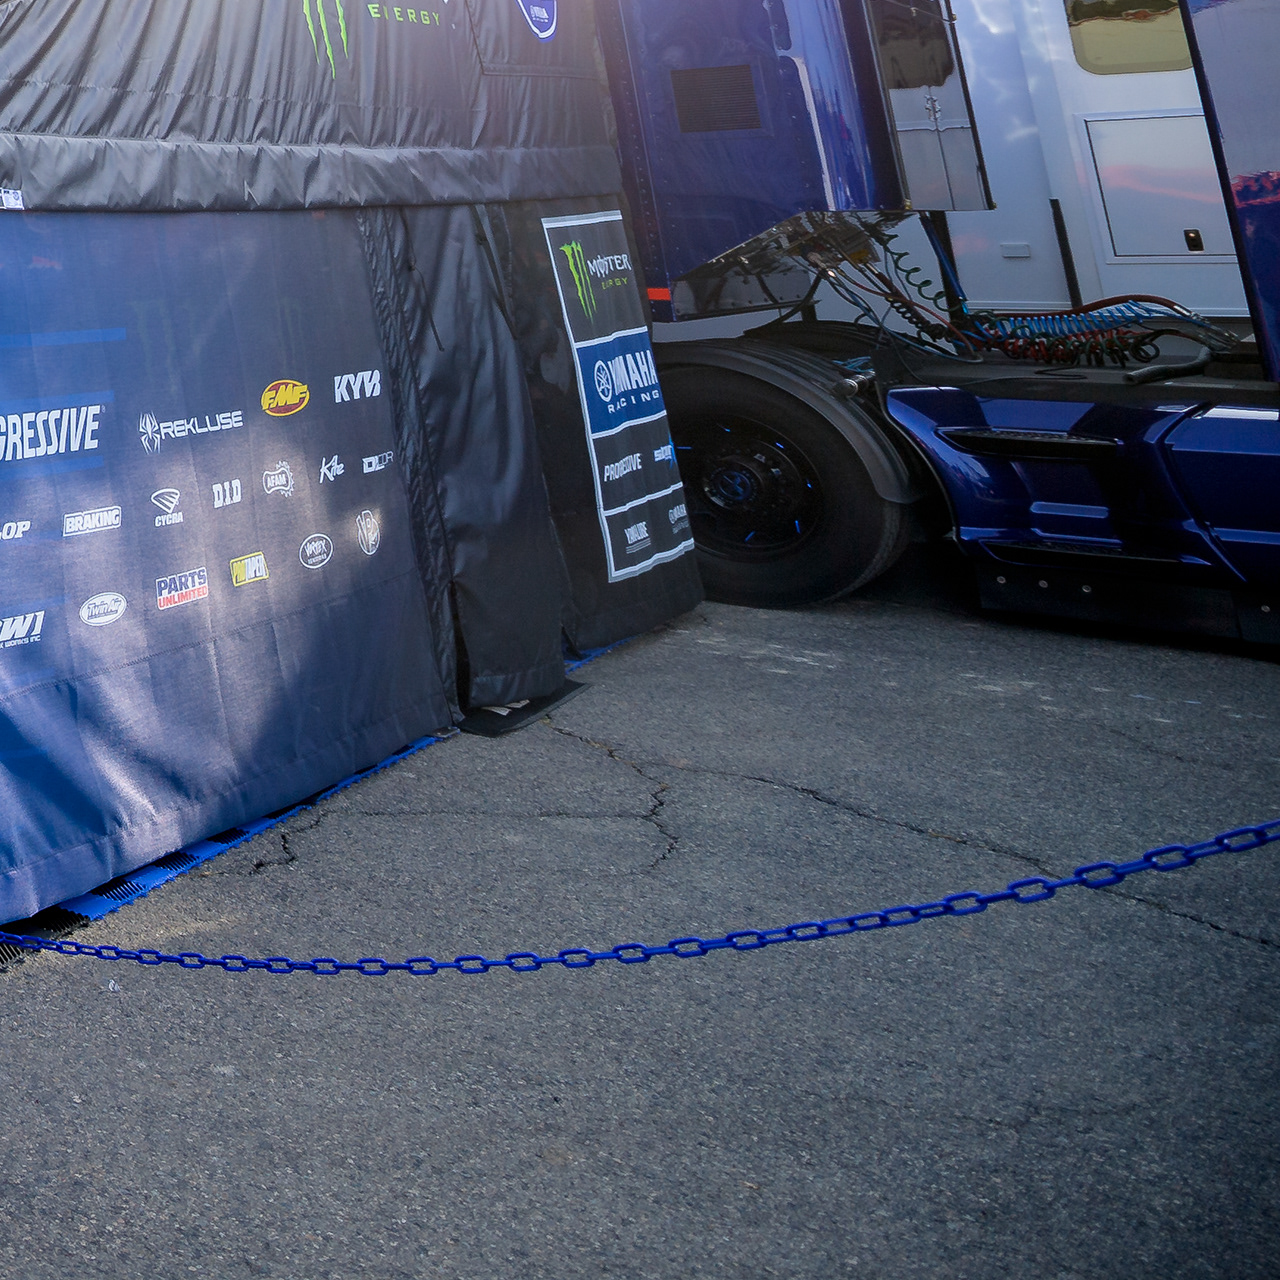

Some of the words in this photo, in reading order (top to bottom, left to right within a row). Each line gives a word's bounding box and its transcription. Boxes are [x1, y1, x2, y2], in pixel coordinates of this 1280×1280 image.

[586, 253, 632, 278] MOTER
[601, 276, 628, 290] ERGY
[611, 349, 659, 396] YMAHA
[262, 383, 309, 411] FMF
[333, 369, 382, 403] KYB
[607, 389, 660, 415] RACING
[160, 410, 244, 440] REKLUSE
[266, 474, 288, 490] AFAM
[319, 454, 345, 484] Kite
[212, 478, 242, 509] D.I.D
[65, 508, 121, 534] BRAKING
[154, 512, 184, 527] CYCRA
[157, 568, 207, 597] PARTS
[87, 602, 108, 619] Twin
[107, 598, 123, 615] Air
[157, 585, 209, 609] UNLIMITED
